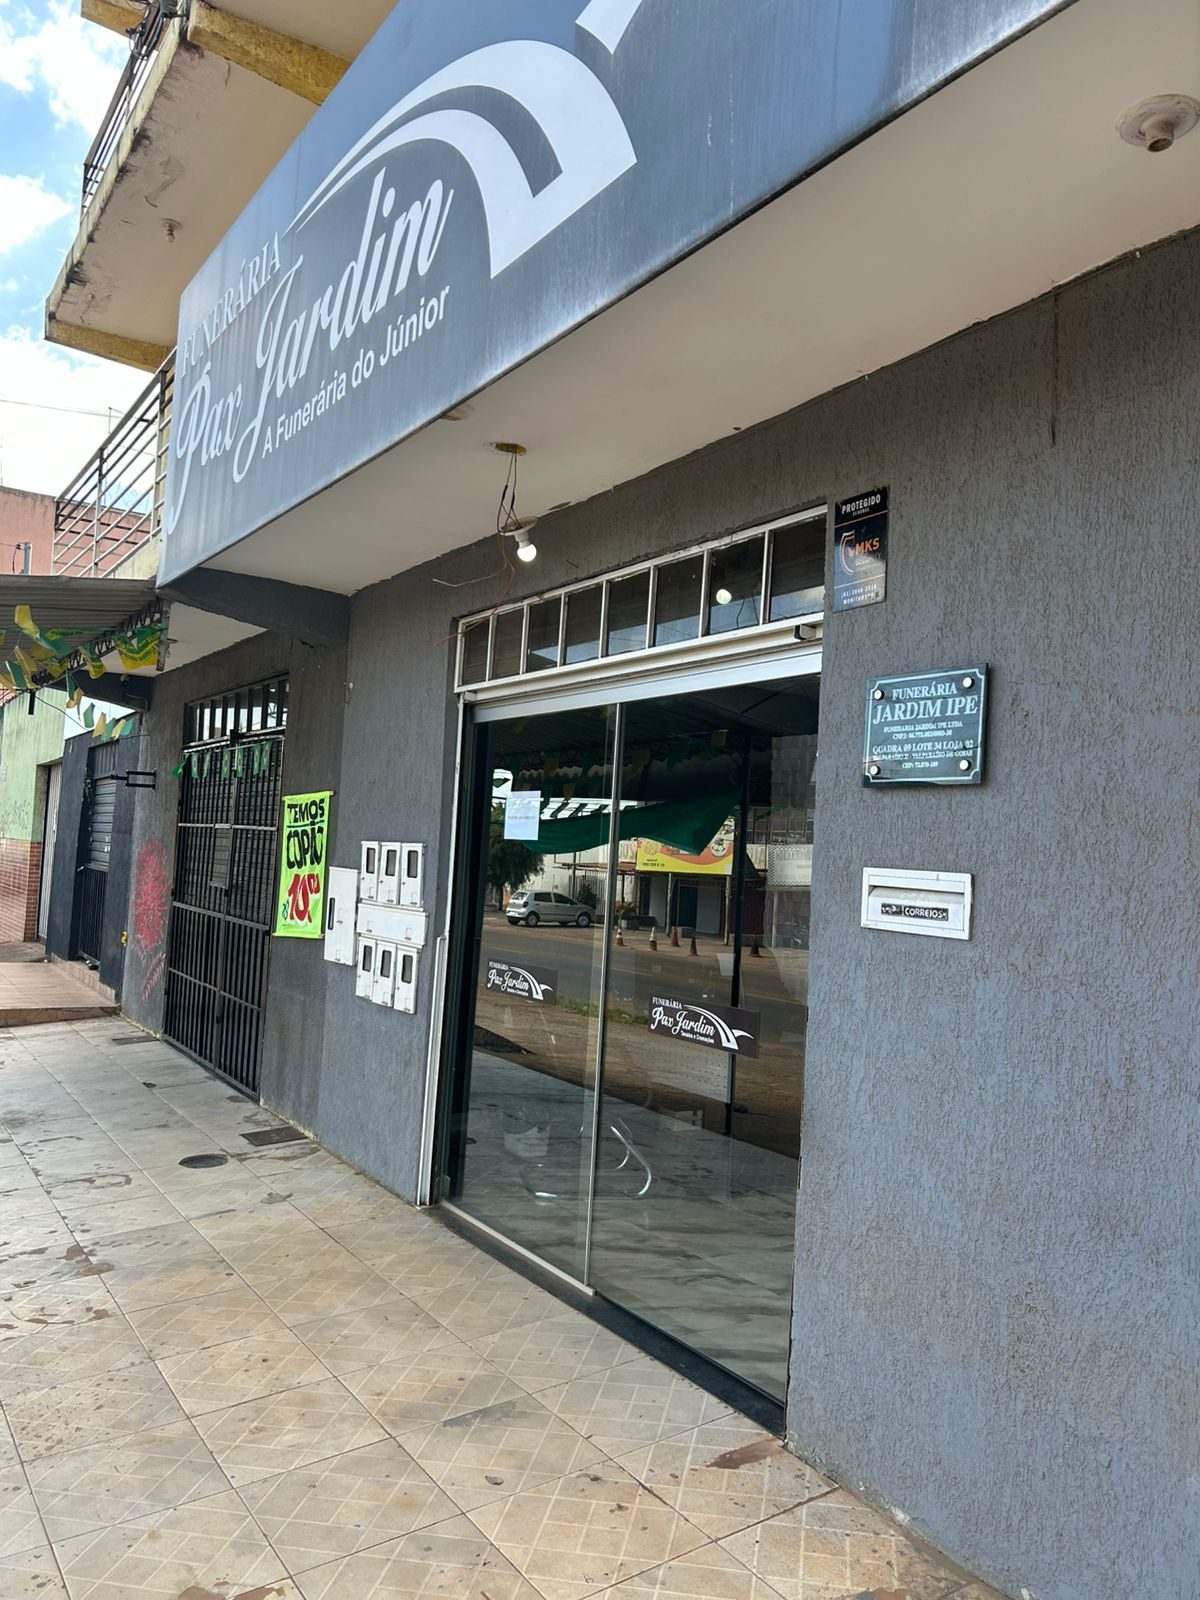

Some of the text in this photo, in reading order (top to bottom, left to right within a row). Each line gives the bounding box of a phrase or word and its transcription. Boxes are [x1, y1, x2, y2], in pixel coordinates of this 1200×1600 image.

[181, 231, 281, 378] FUNERÁRIA
[167, 166, 454, 535] Pax Jardim
[262, 285, 450, 459] A Funerária do Júnior
[841, 494, 881, 515] PROTEGIDO
[855, 537, 880, 554] MKS
[892, 681, 958, 701] FUNERÁRIA
[873, 695, 978, 725] JARDIM IPE
[872, 743, 902, 755] QUADRA
[903, 743, 912, 752] 09
[912, 742, 934, 751] LOTE
[943, 740, 963, 750] LOJA
[287, 798, 325, 824] TEMOS
[287, 820, 324, 869] COPÃO
[904, 907, 943, 918] CORREIOS
[500, 971, 529, 991] Jardim
[652, 996, 682, 1010] FUNERÁRIA
[650, 1006, 716, 1037] Pax Jardim
